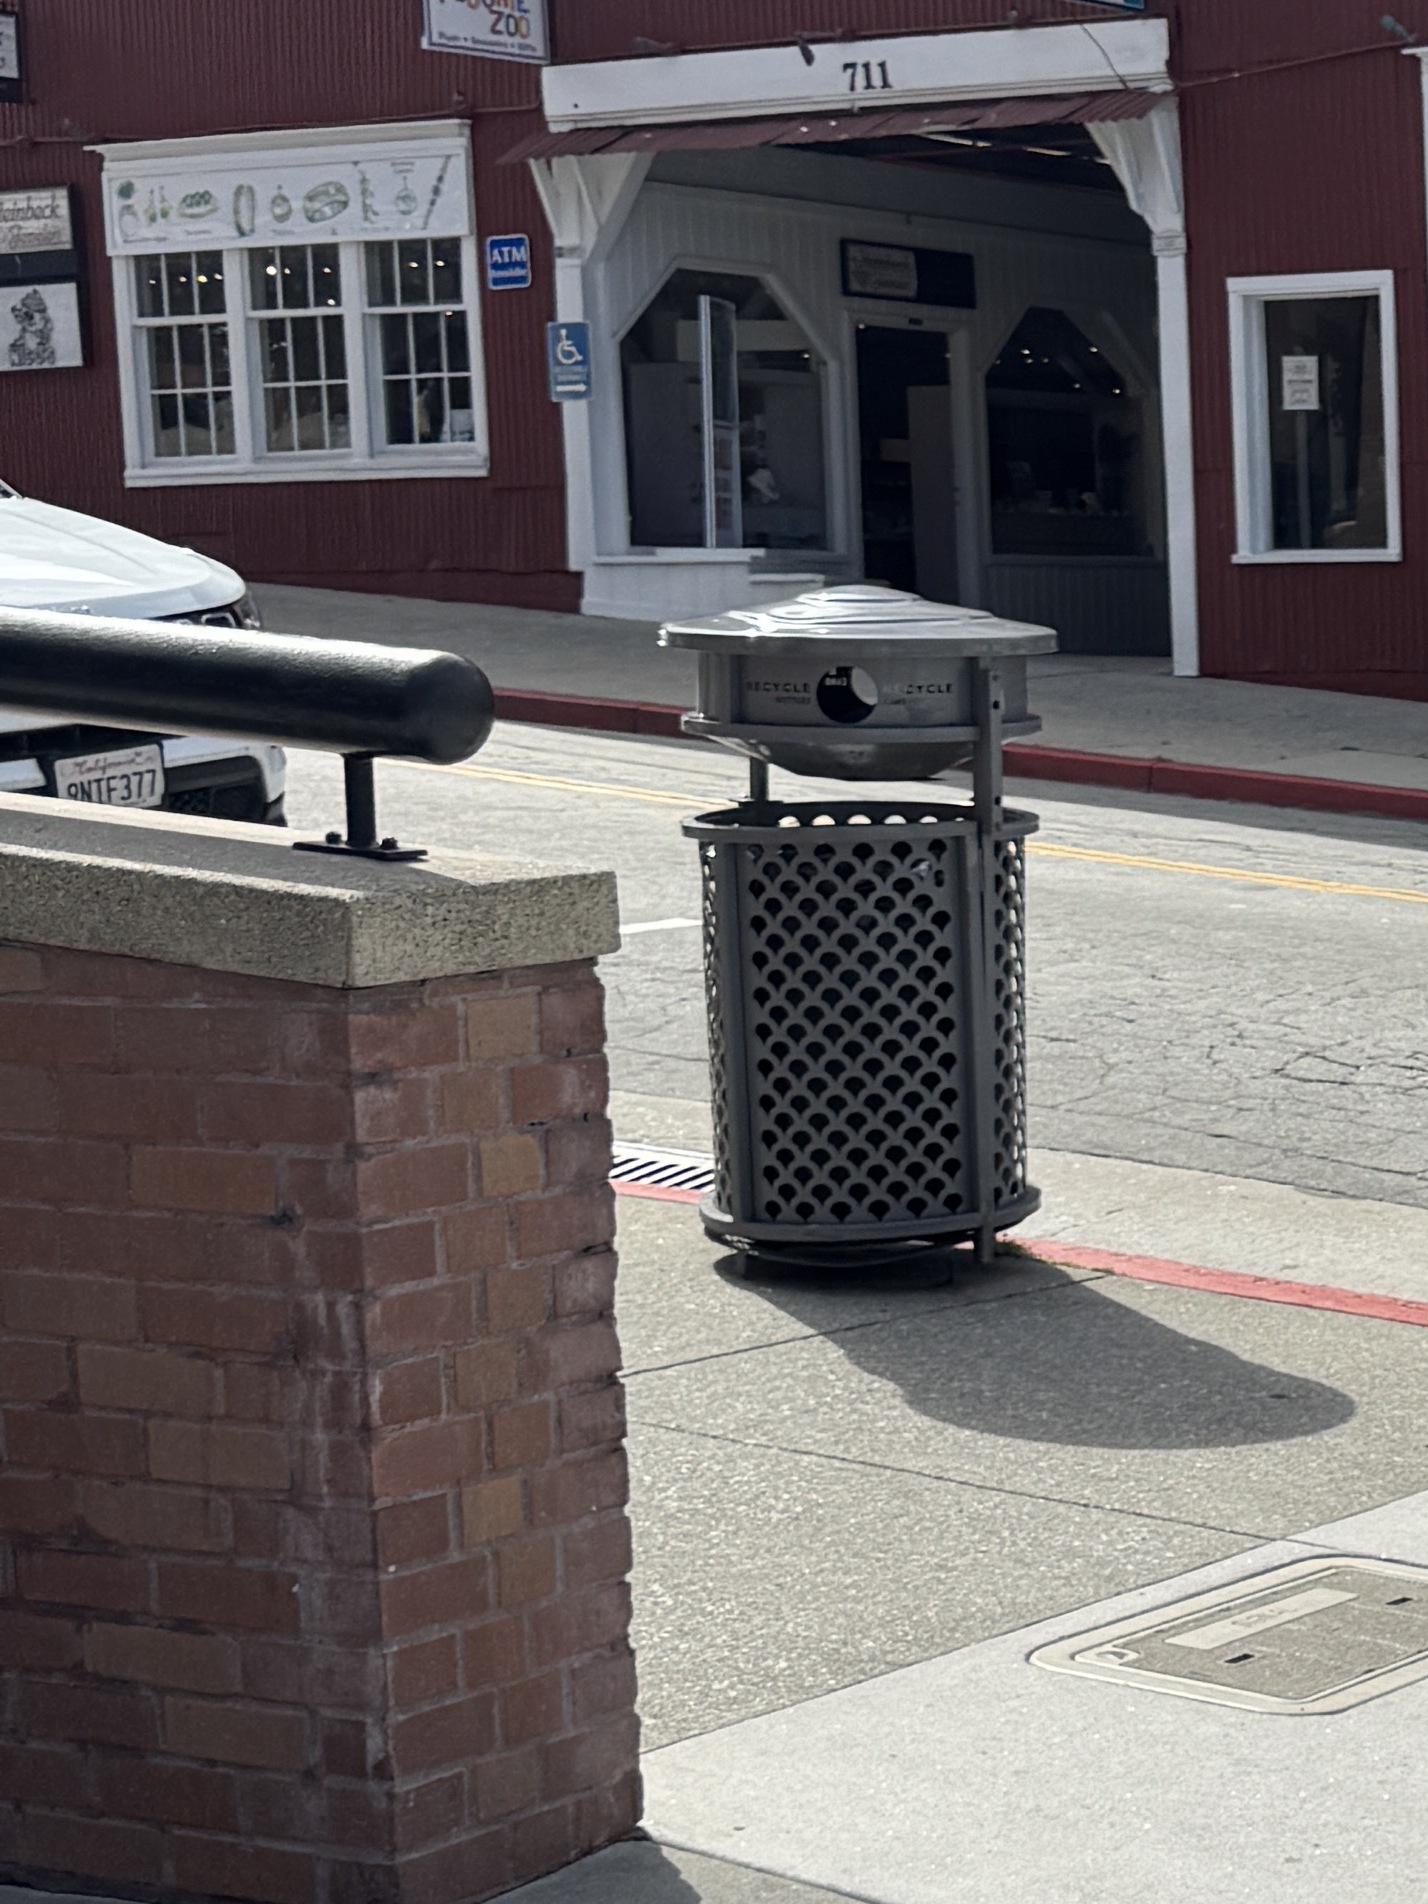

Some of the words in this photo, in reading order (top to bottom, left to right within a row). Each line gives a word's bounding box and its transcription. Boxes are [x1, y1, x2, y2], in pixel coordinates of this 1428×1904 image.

[489, 8, 531, 40] ZOO
[843, 60, 893, 92] 711
[491, 246, 527, 264] ATM
